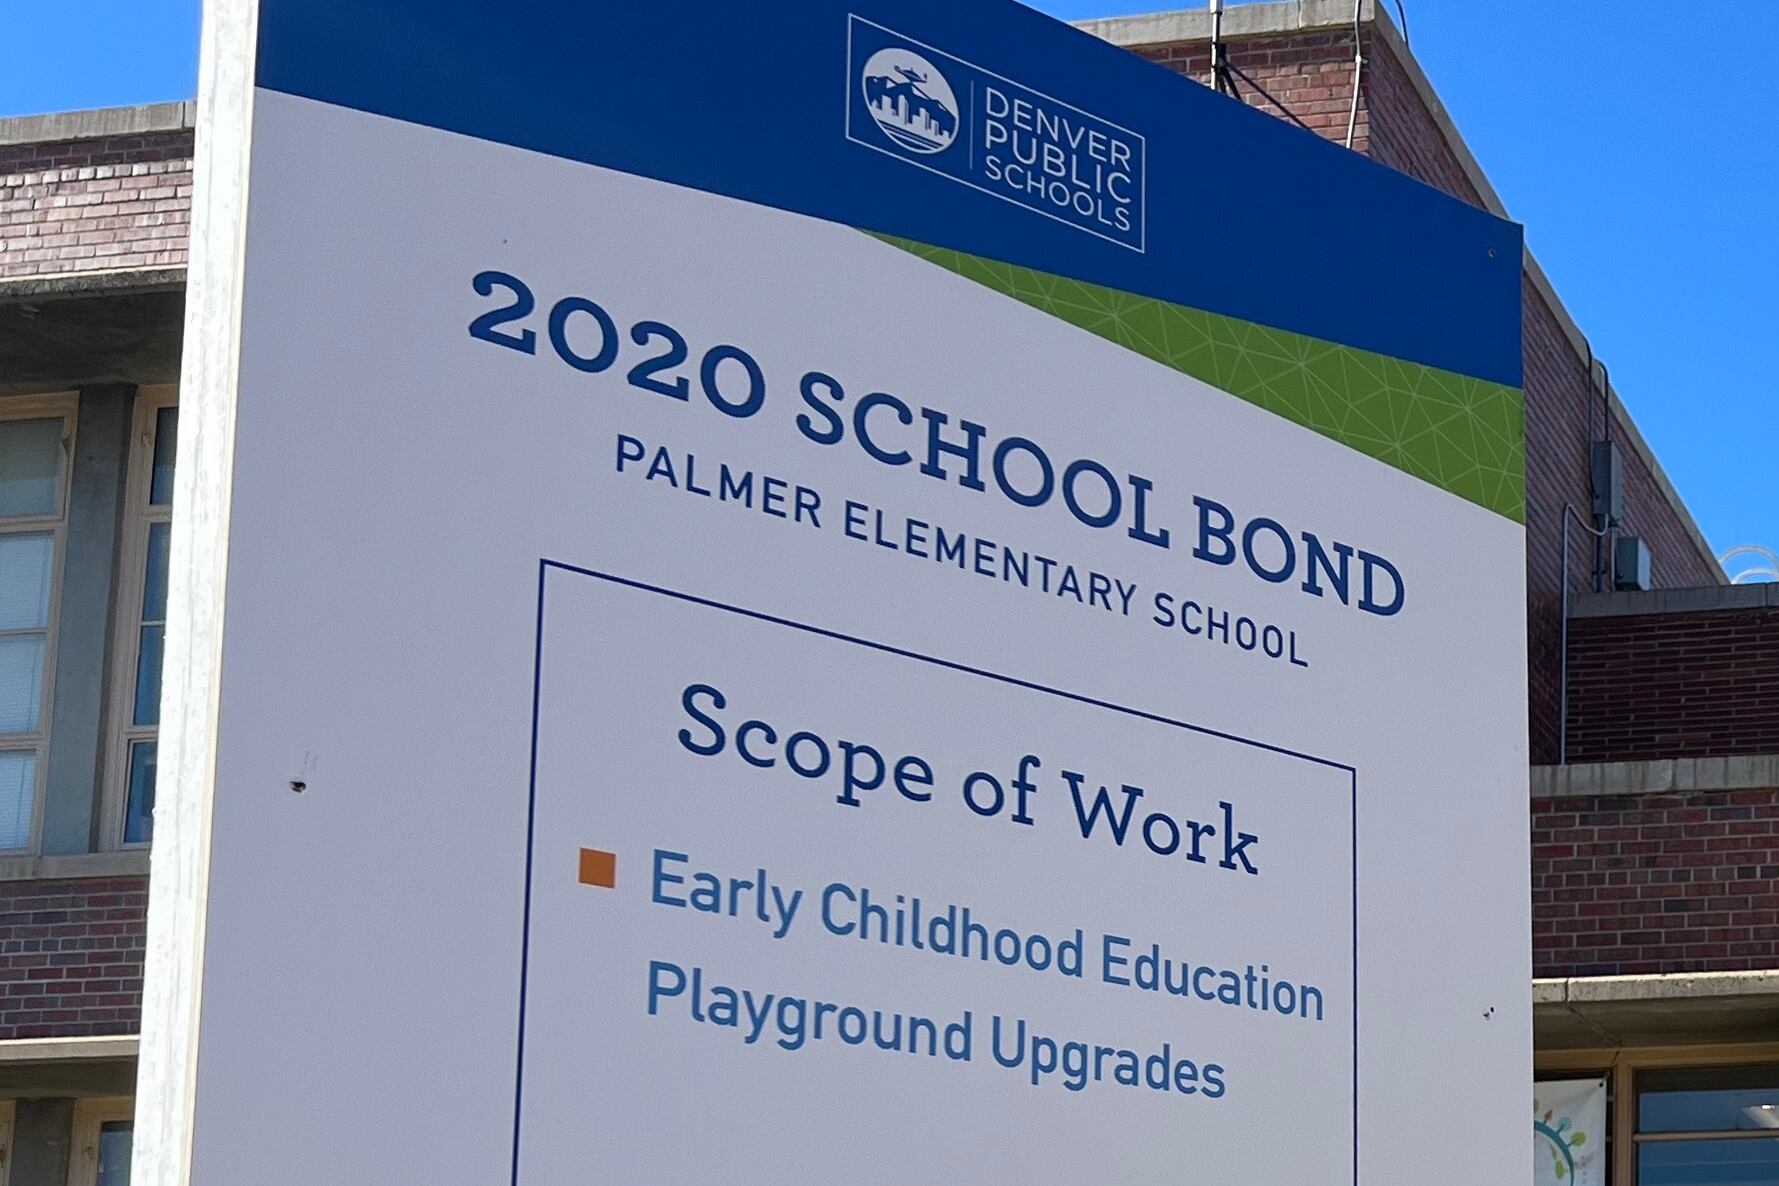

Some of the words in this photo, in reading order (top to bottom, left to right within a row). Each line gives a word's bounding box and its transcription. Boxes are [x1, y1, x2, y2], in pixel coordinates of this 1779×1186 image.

[984, 154, 1132, 232] SCHOOLS
[985, 86, 1132, 173] DENVER
[985, 118, 1132, 205] PUBLIC
[467, 270, 767, 420] 2020
[795, 371, 1170, 549] SCHOOL
[1191, 494, 1406, 617] BOND
[615, 433, 823, 530] PALMER
[844, 501, 1137, 617] ELEMENTARY
[1152, 591, 1310, 668] SCHOOL
[677, 683, 935, 807] Scope
[962, 754, 1042, 827] of
[1061, 769, 1260, 876] Work
[650, 847, 804, 940] Early
[820, 882, 1085, 979] Childhood
[1101, 933, 1326, 1021] Education
[646, 959, 973, 1062] Playground
[990, 1015, 1227, 1100] Upgrades
